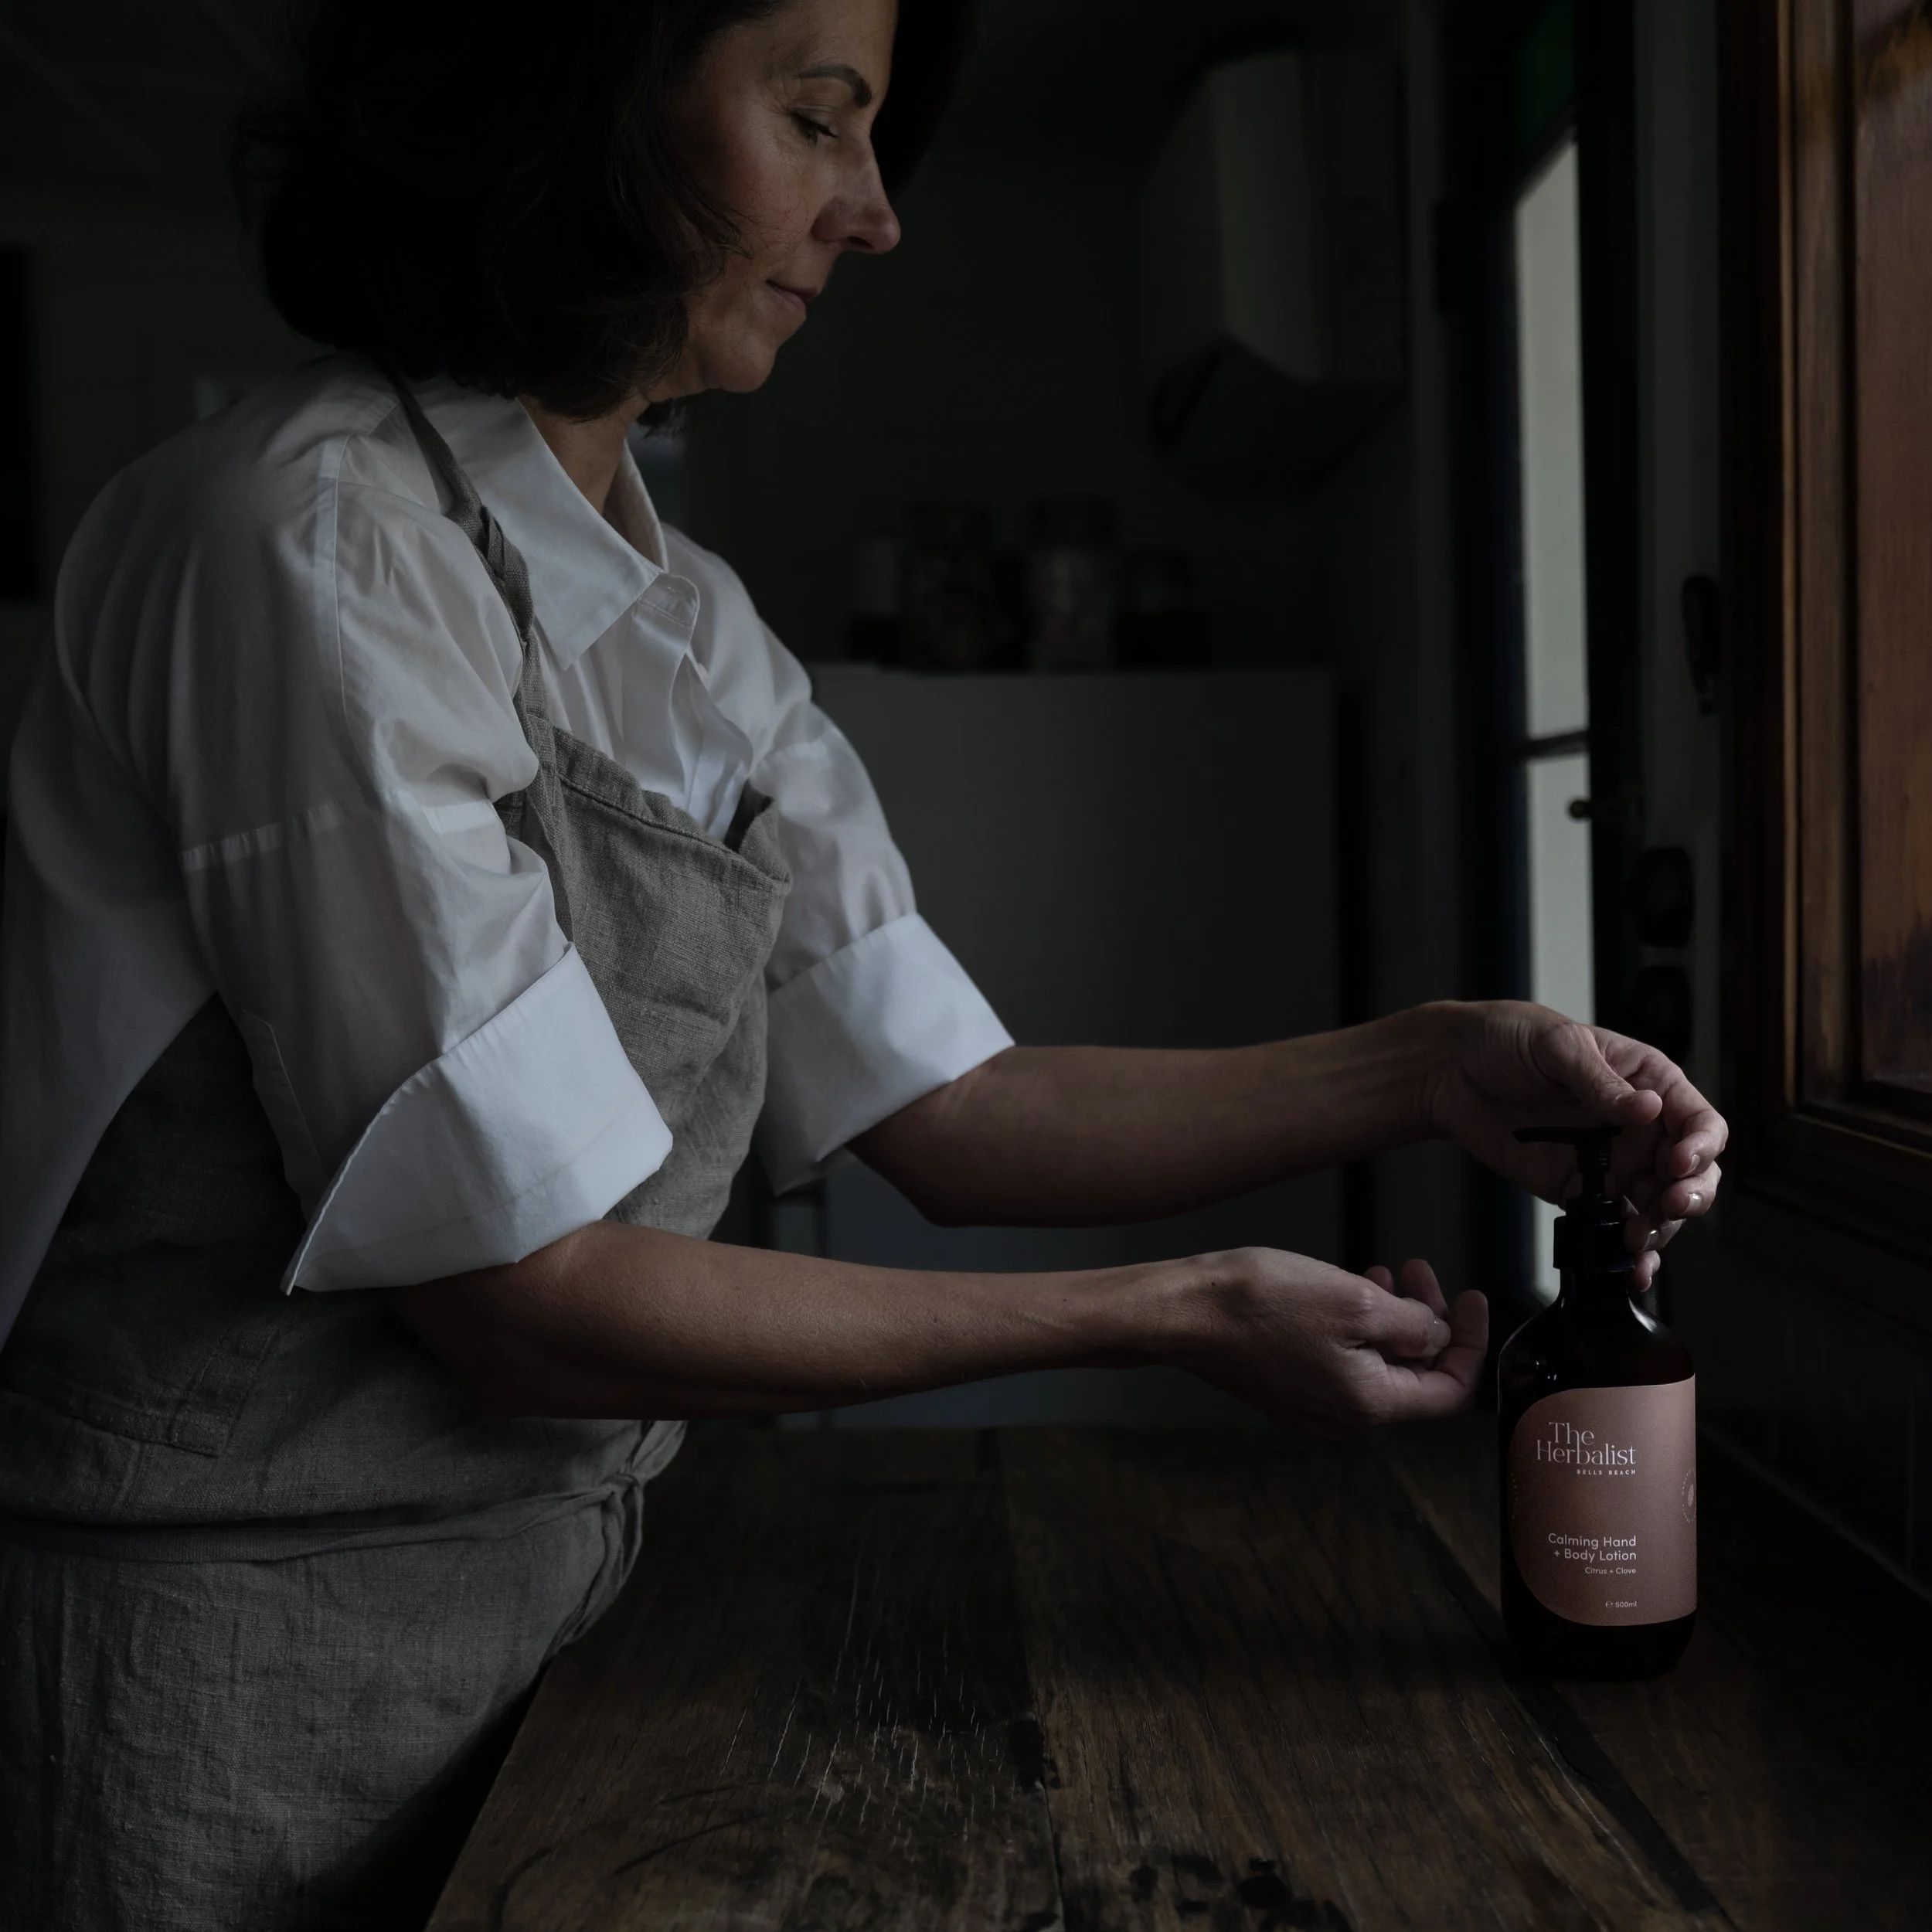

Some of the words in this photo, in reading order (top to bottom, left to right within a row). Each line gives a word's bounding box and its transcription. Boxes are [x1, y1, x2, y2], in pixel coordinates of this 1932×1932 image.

[1549, 1422, 1594, 1445] The
[1537, 1440, 1636, 1465] Herbalist
[1549, 1533, 1599, 1550] Calming
[1604, 1536, 1636, 1546] Hand
[1564, 1549, 1595, 1563] Body
[1600, 1549, 1637, 1561] Lotion
